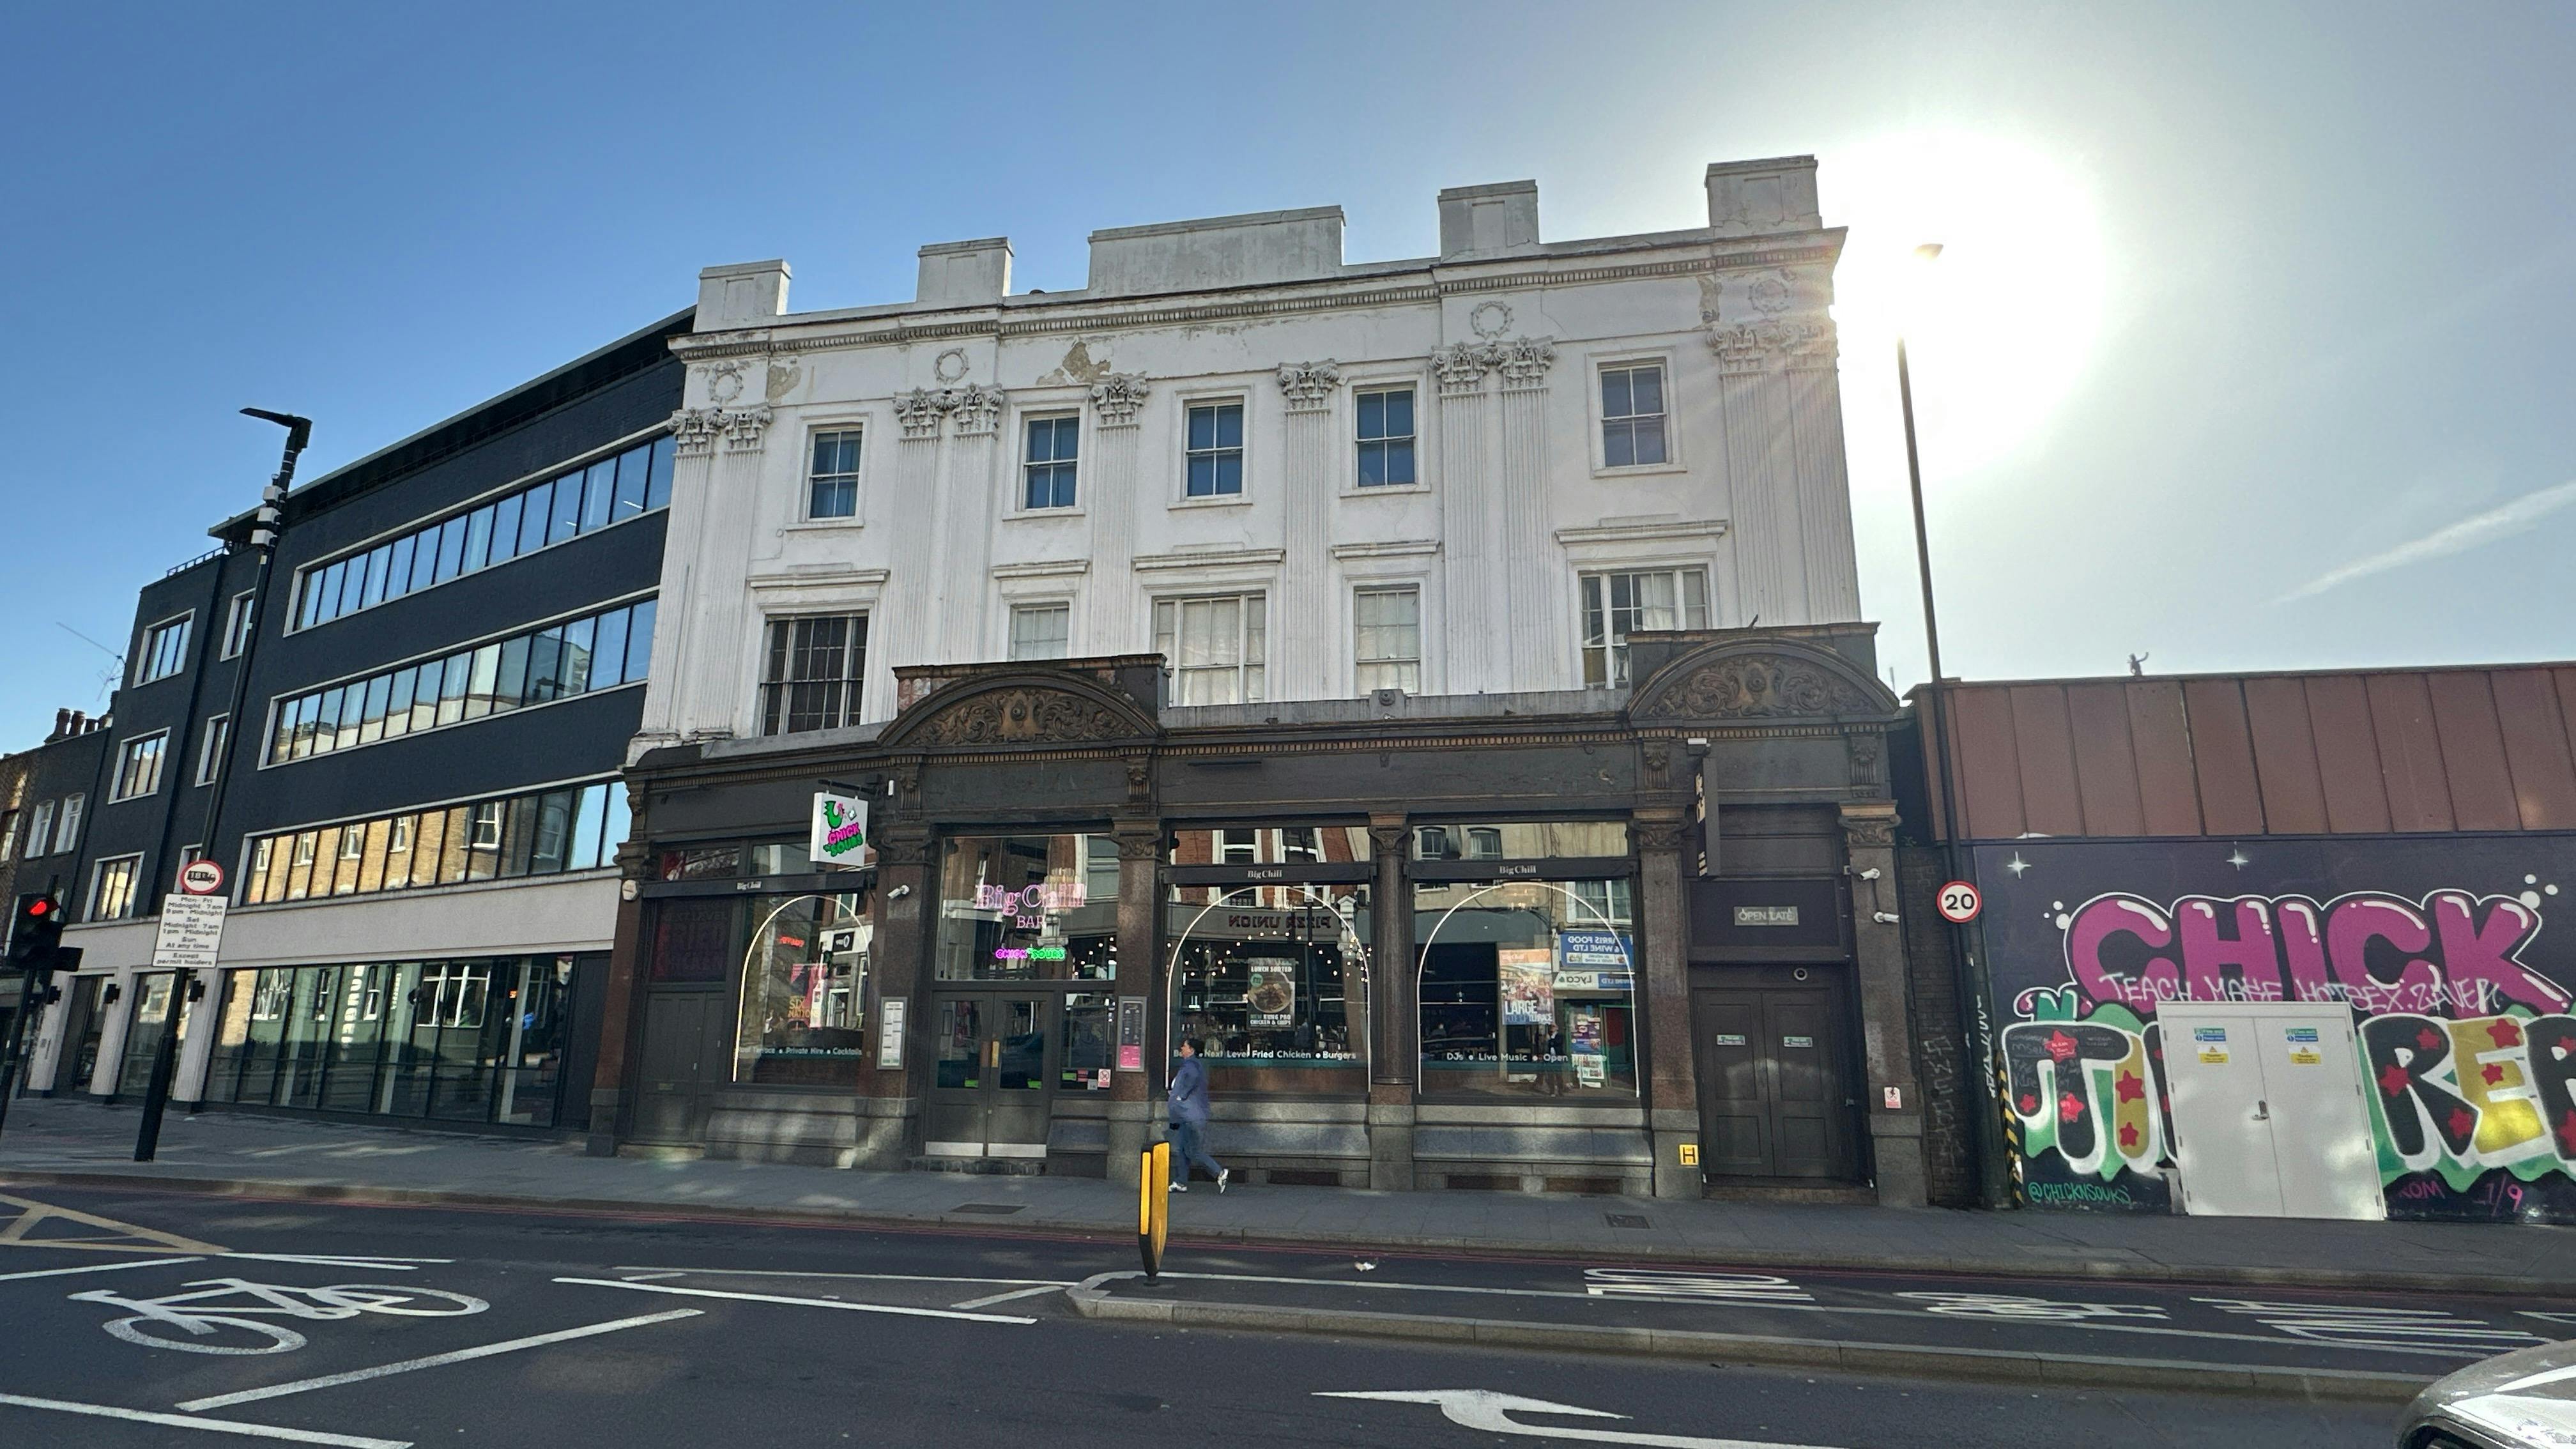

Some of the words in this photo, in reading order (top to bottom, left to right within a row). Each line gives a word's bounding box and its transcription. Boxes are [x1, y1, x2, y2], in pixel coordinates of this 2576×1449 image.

[827, 822, 861, 845] CHICK
[830, 832, 863, 857] SOURS
[1945, 893, 1975, 910] 20
[1738, 908, 1767, 921] OPEN
[1016, 915, 1046, 930] BAR
[995, 948, 1027, 959] CHICK
[1031, 947, 1066, 960] SOURS
[2069, 894, 2575, 1018] CHICK
[1505, 1000, 1537, 1015] LARGE
[786, 1046, 808, 1054] Private
[810, 1046, 824, 1055] Hire
[832, 1046, 862, 1055] Cocktails
[1204, 1050, 1223, 1058] Next
[1252, 1049, 1274, 1058] Fried
[1276, 1049, 1312, 1059] Chicken
[1322, 1050, 1356, 1061] Burgers
[1446, 1052, 1464, 1061] DJs
[1478, 1053, 1498, 1061] Live
[1501, 1053, 1528, 1061] Music
[1543, 1054, 1568, 1063] Open
[1682, 1147, 1696, 1163] H
